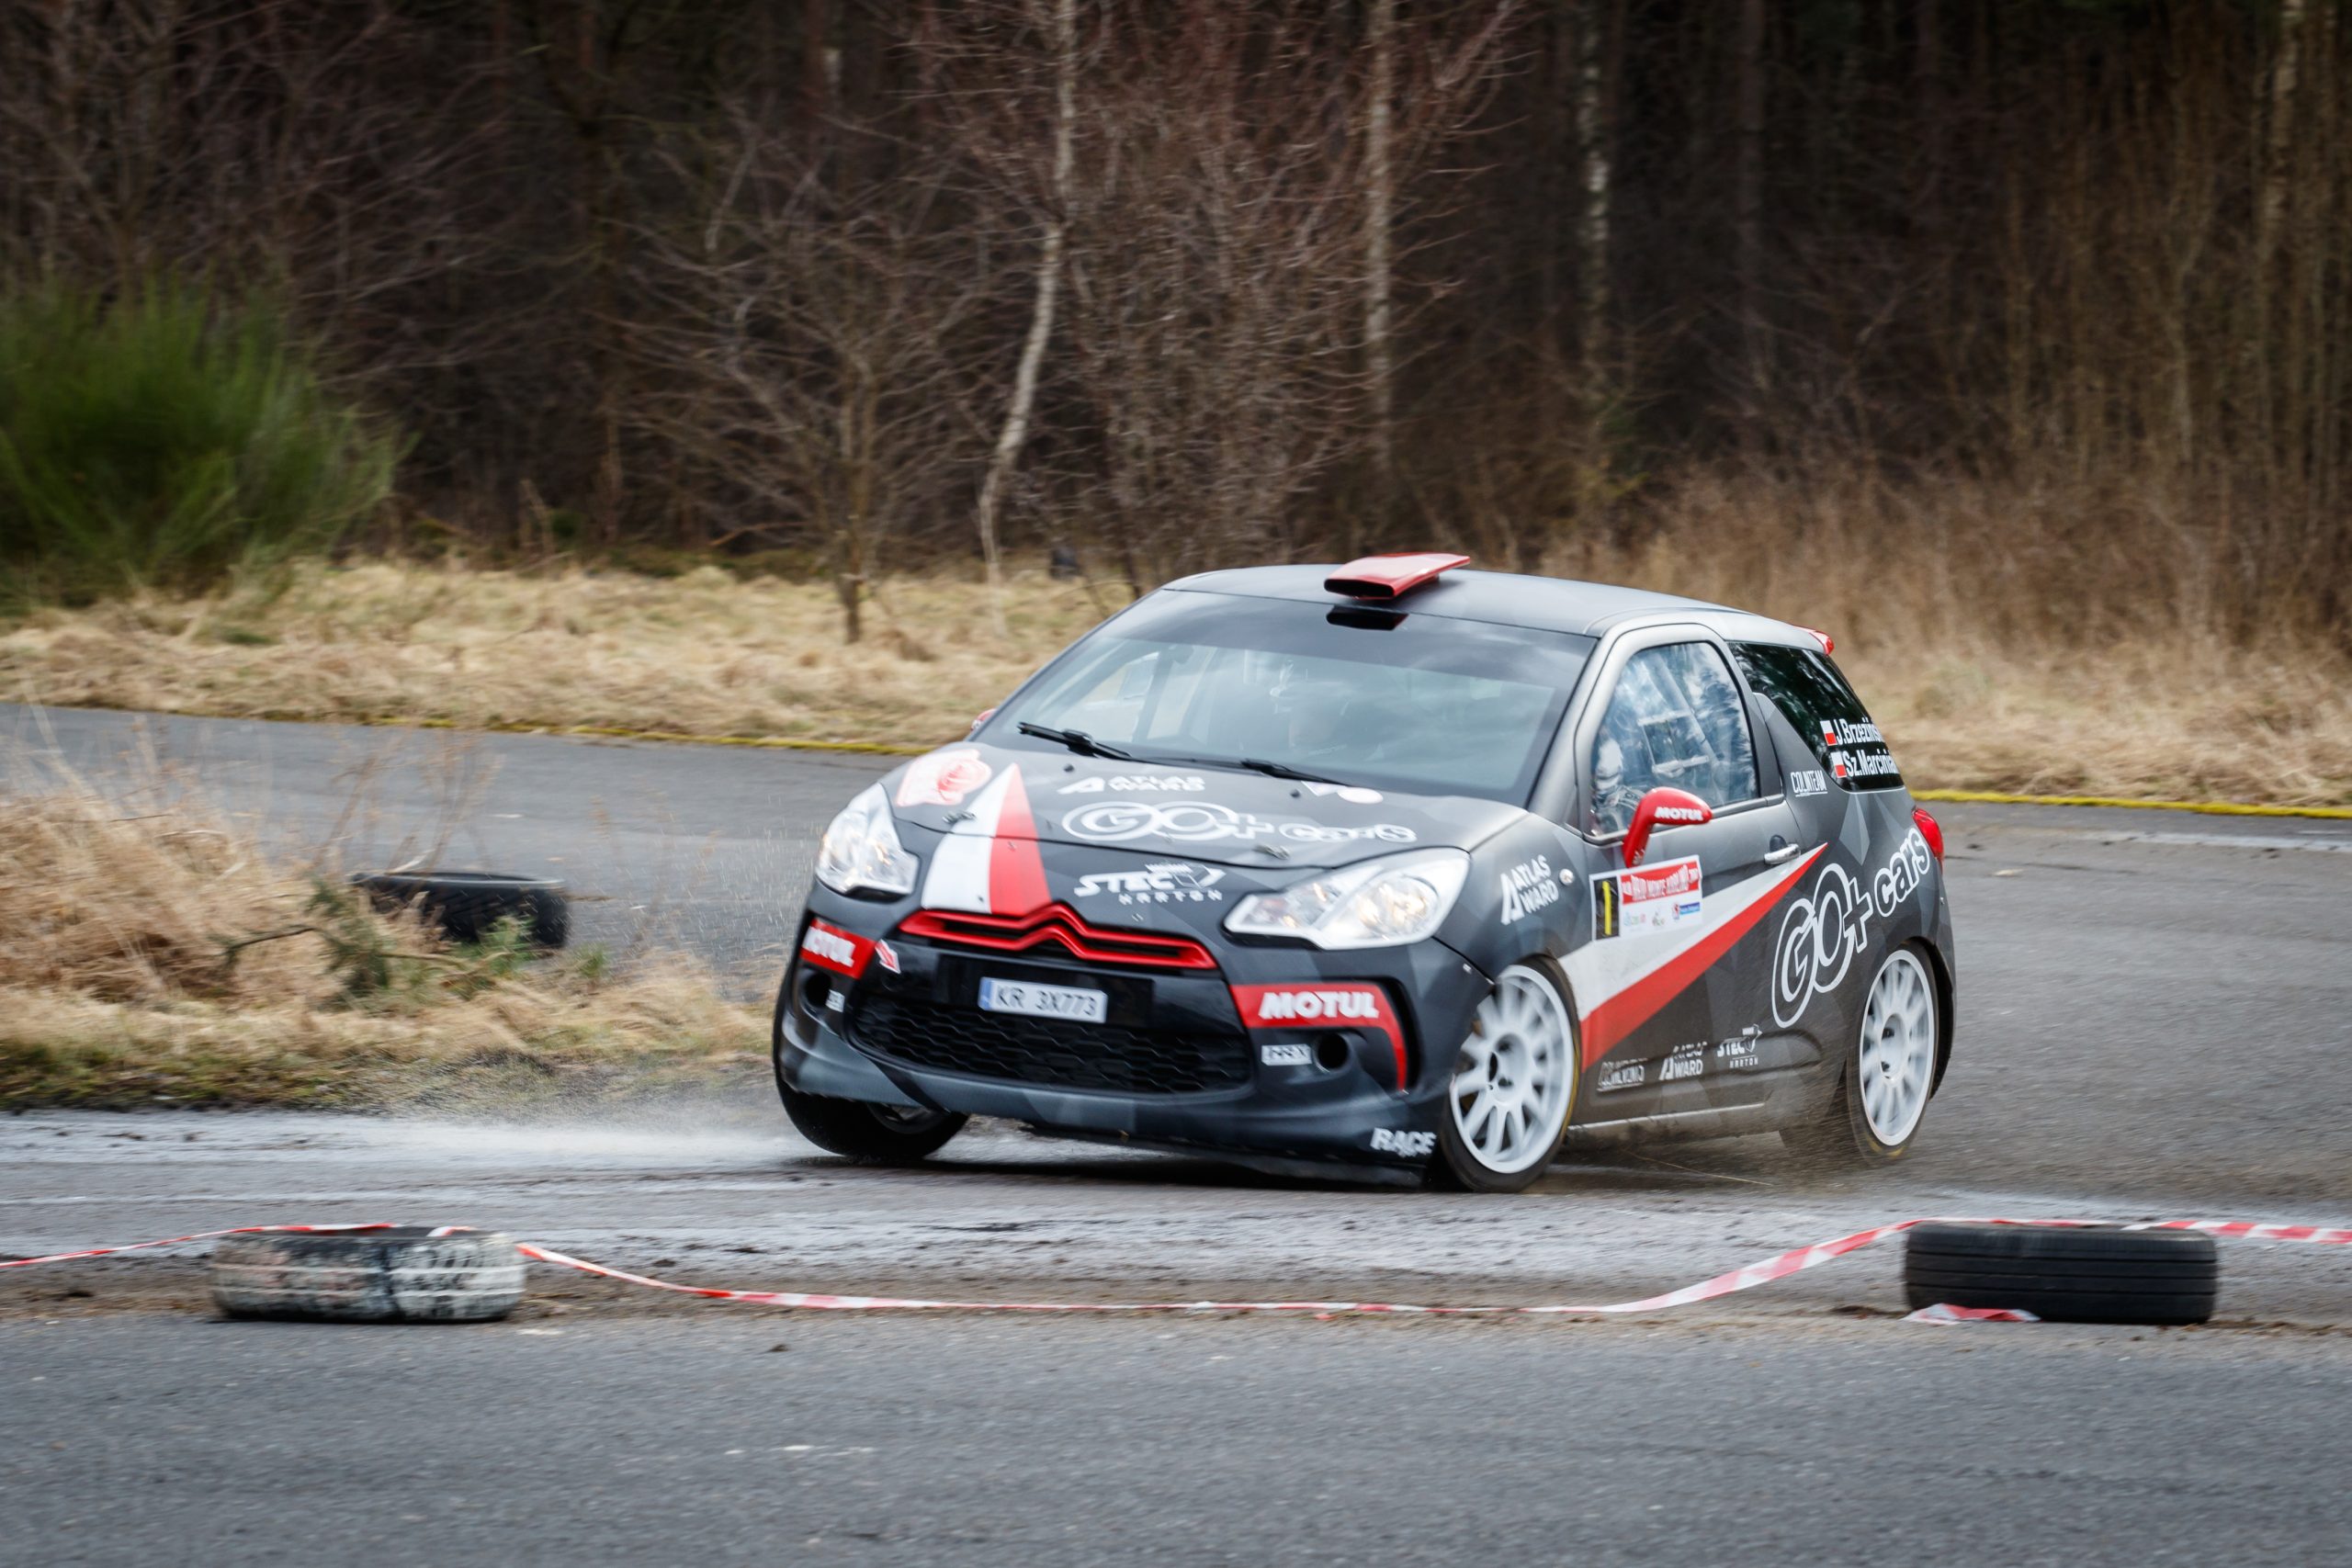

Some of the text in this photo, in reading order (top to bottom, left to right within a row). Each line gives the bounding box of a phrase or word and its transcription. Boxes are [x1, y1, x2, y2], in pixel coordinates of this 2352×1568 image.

[1842, 749, 1900, 777] Sz.Marcinia
[1655, 807, 1704, 821] MOTUL
[1074, 871, 1176, 897] STEC
[1510, 854, 1552, 891] ATLAS
[1519, 879, 1559, 914] WARD
[1601, 880, 1612, 936] 1
[996, 985, 1098, 1017] KR 3X773
[1259, 991, 1379, 1021] MOTUL
[1674, 1058, 1703, 1079] WARD
[1370, 1127, 1437, 1157] RACE
